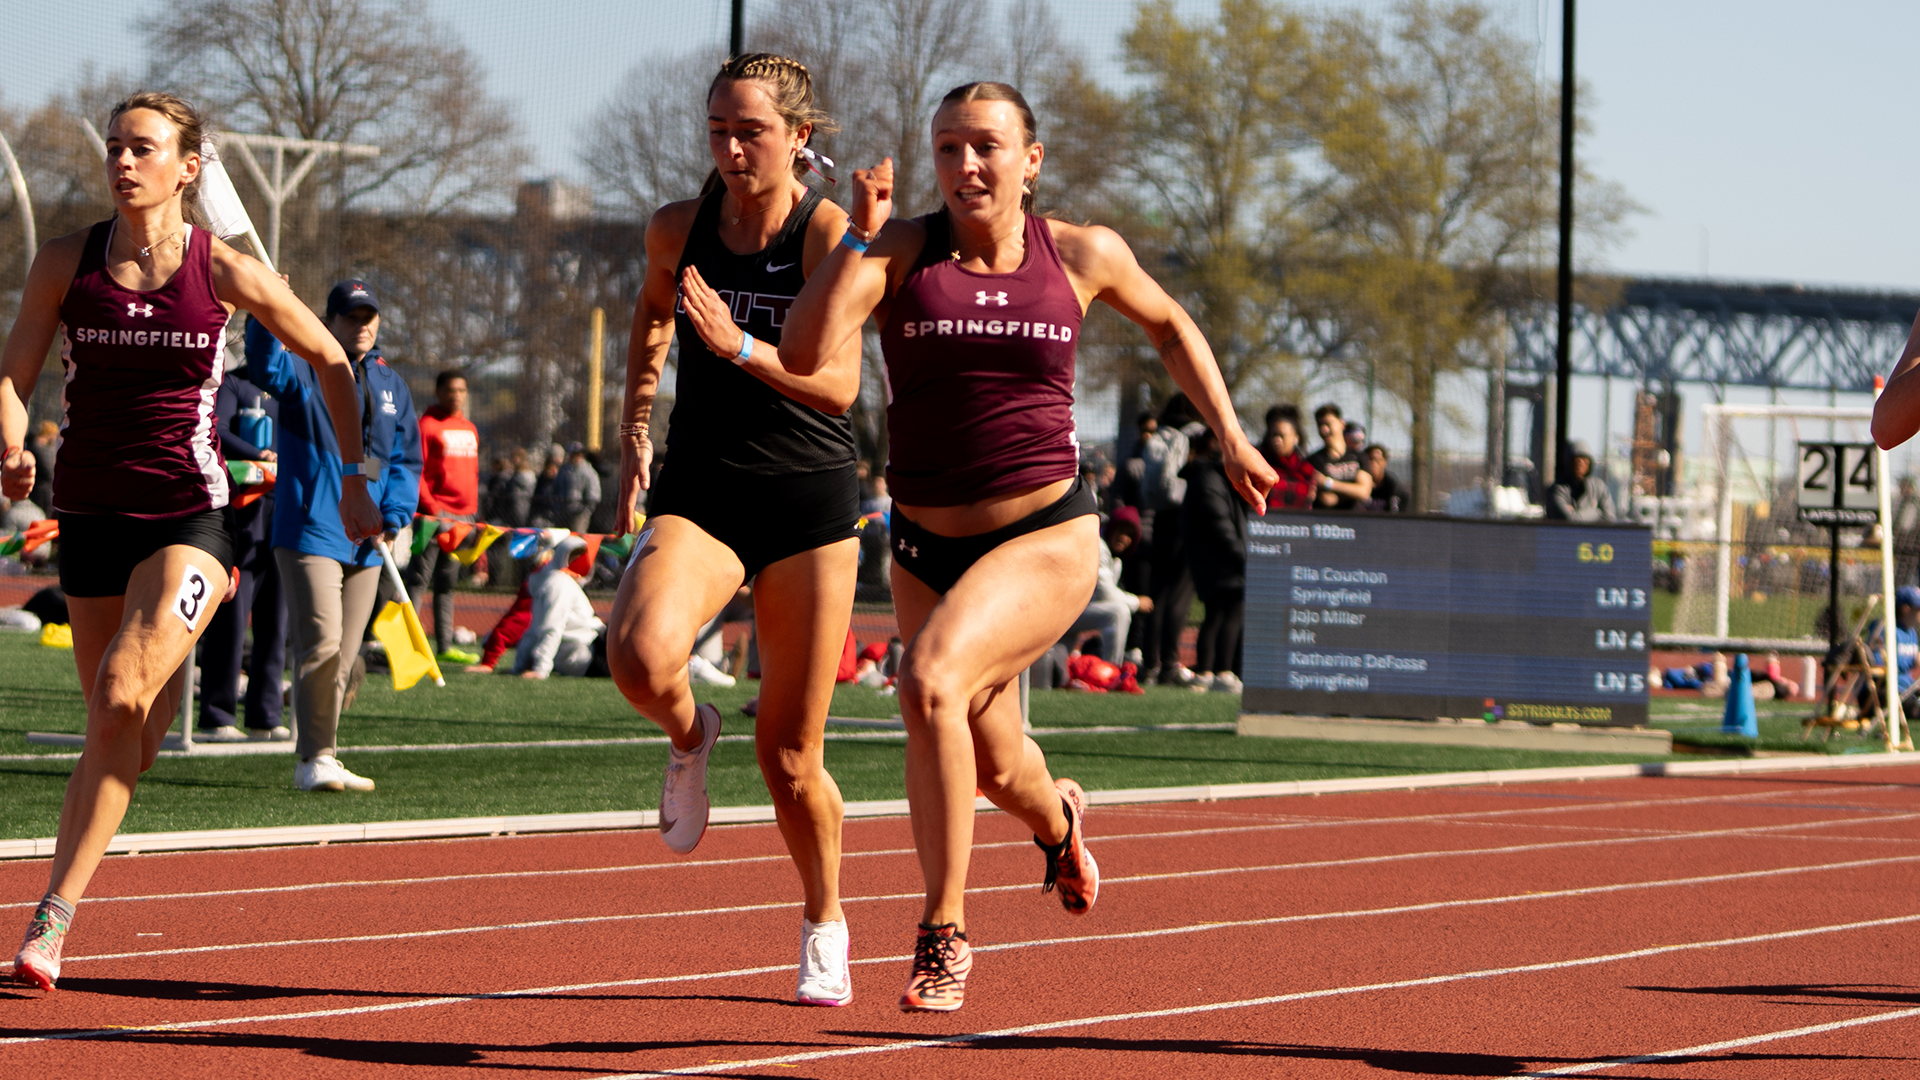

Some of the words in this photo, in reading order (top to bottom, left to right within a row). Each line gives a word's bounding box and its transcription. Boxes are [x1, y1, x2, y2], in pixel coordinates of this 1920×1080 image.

[76, 327, 210, 349] SPRINGFIELD
[903, 319, 1073, 343] SPRINGFIELD
[1803, 446, 1830, 490] 2
[1849, 446, 1873, 493] 4
[1802, 508, 1836, 520] LAPS
[1838, 509, 1856, 521] TO
[1857, 509, 1877, 522] GO
[1249, 520, 1310, 538] Women
[1312, 523, 1356, 540] 100m
[1249, 541, 1282, 556] Heat
[1578, 542, 1614, 563] 6.0
[1291, 565, 1319, 581] Ella
[1321, 566, 1388, 584] Couchon
[180, 573, 205, 621] 3
[1291, 585, 1372, 607] Springfield
[1597, 587, 1628, 608] LN
[1631, 588, 1646, 609] 3
[1321, 609, 1366, 625] Miller
[1596, 629, 1627, 650] LN
[1629, 631, 1645, 651] 4
[1288, 651, 1363, 667] Katherine
[1363, 653, 1428, 671] DeFosse
[1288, 671, 1369, 693] Springfield
[1595, 672, 1626, 693] LN
[1628, 673, 1645, 693] 5
